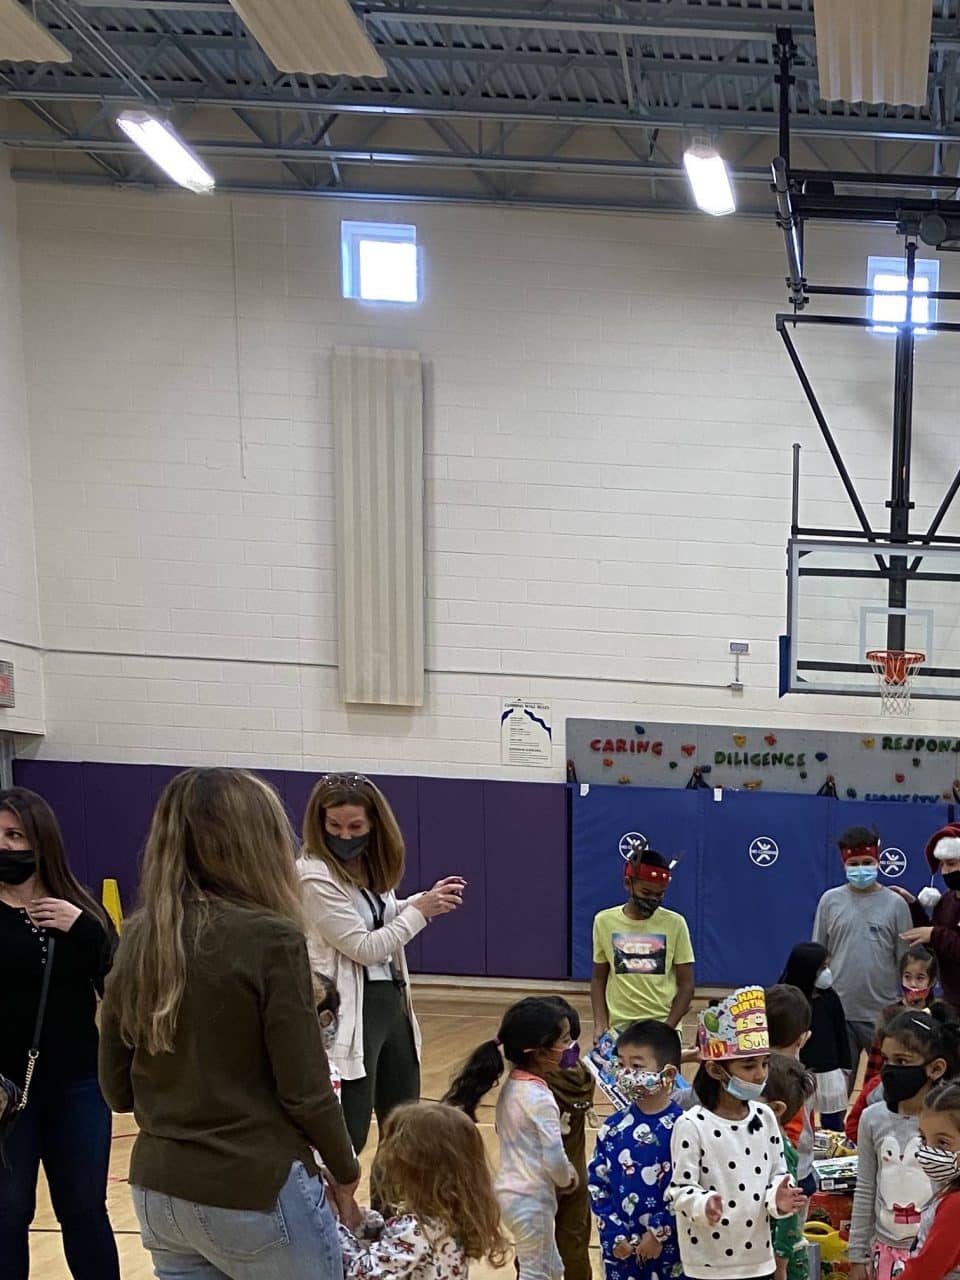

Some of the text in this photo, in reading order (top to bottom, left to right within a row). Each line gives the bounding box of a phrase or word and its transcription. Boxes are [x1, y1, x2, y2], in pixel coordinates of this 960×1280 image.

[590, 738, 663, 756] CARING
[714, 751, 806, 767] DILIGENCE
[738, 989, 765, 1003] HAPP
